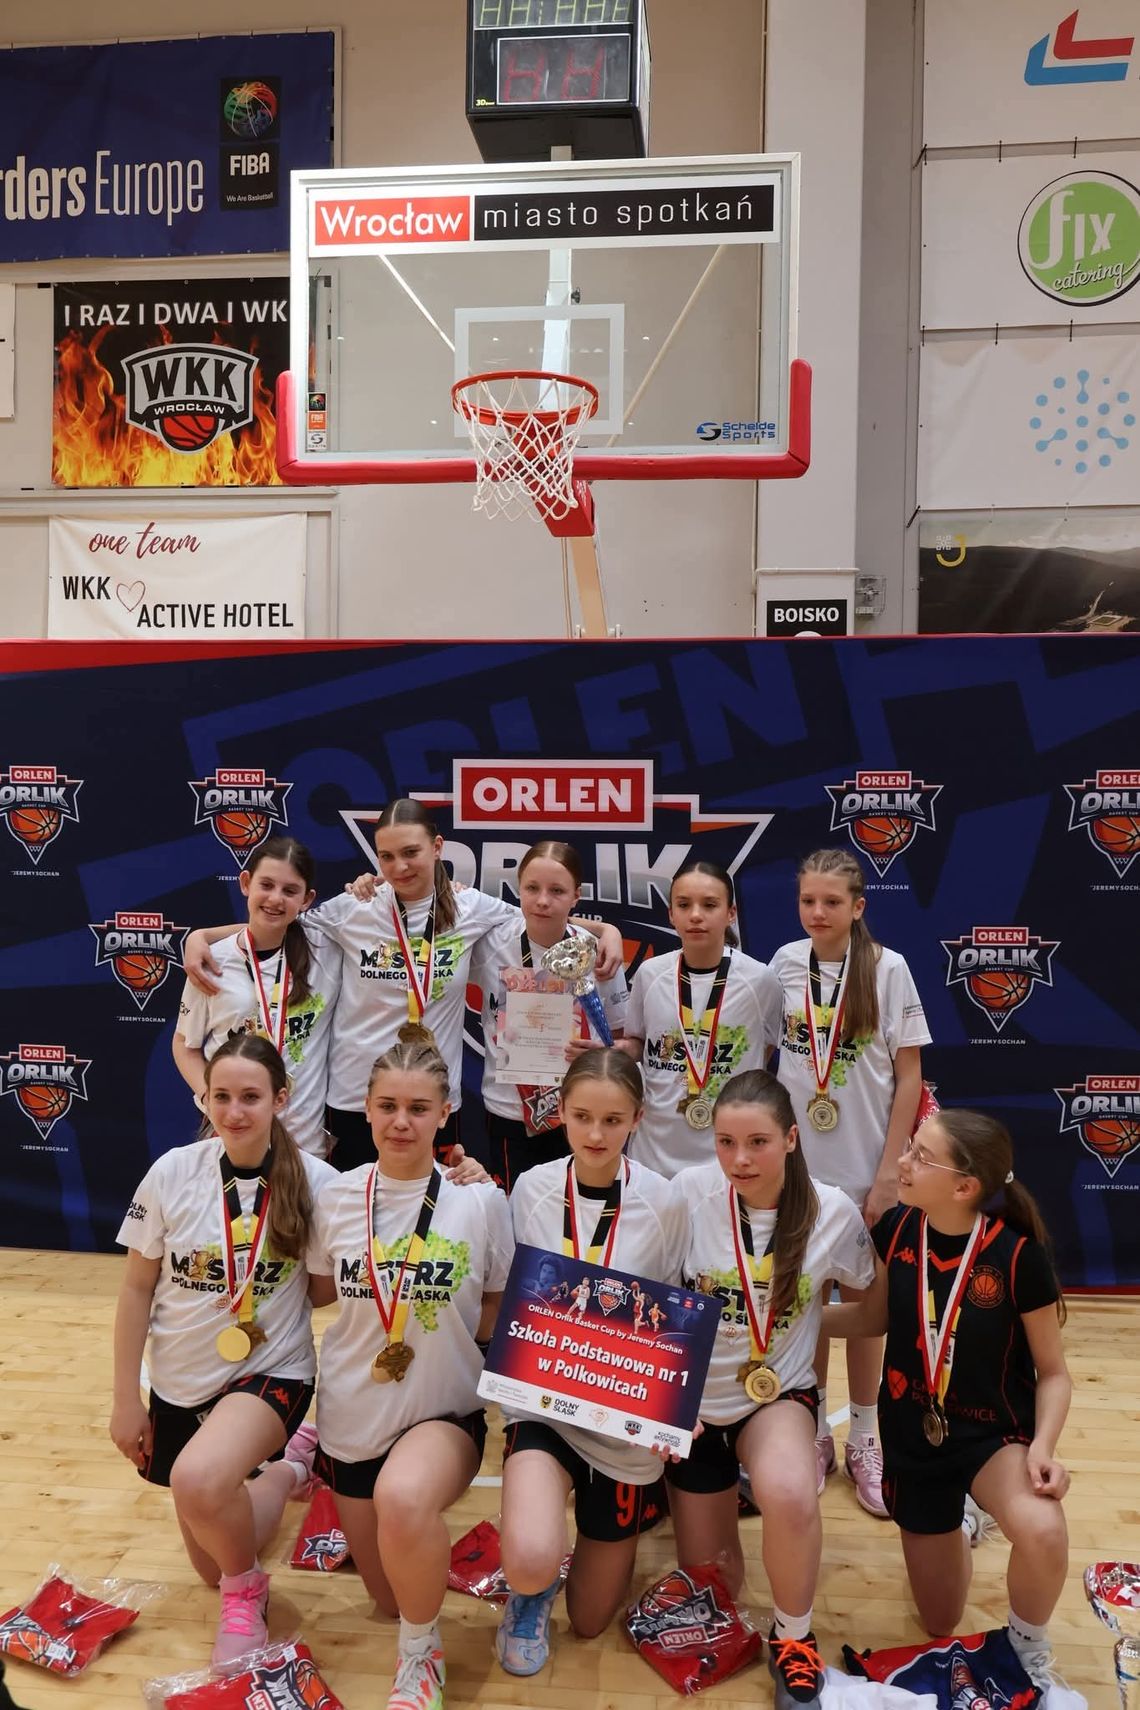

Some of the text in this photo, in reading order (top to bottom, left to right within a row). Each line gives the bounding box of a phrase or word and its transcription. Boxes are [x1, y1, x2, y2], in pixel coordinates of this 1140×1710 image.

[230, 152, 270, 176] FIBA
[95, 151, 204, 226] Europe
[320, 192, 752, 238] Wrocław miasto spotkań
[1052, 261, 1128, 291] catering
[64, 300, 288, 327] I RAZ I DWA I WK
[141, 356, 237, 402] WKK
[154, 402, 225, 416] WROCŁAW
[722, 422, 776, 431] Schelde
[722, 430, 776, 441] Sports
[88, 522, 201, 559] one team
[62, 576, 111, 600] WKK
[137, 603, 294, 628] ACTIVE HOTEL
[774, 607, 840, 623] BOISKO
[14, 770, 52, 780] ORLEN
[220, 773, 261, 783] ORLEN
[861, 776, 906, 786] ORLEN
[1101, 775, 1140, 785] ORLE
[0, 785, 69, 808] ORLIK
[204, 789, 278, 811] ORLIK
[472, 777, 633, 813] ORLEN
[841, 793, 925, 815] ORLIK
[1081, 792, 1140, 814] ORL
[440, 840, 692, 909] ORIK
[120, 916, 159, 926] ORLEN
[104, 932, 176, 954] ORLIK
[978, 931, 1023, 942] ORLEN
[958, 948, 1041, 970] ORLIK
[360, 970, 407, 980] DOLNEGO
[23, 1048, 61, 1059] ORLEN
[7, 1063, 78, 1086] ORLIK
[1091, 1080, 1137, 1089] ORLEN
[340, 1286, 375, 1299] DOLNE
[528, 1304, 555, 1317] ORLEN
[574, 1317, 600, 1331] Basket
[600, 1325, 616, 1336] Cup
[616, 1329, 627, 1340] by
[627, 1333, 656, 1348] Jeremy
[655, 1341, 683, 1355] Sochan
[508, 1320, 689, 1387] Szkoła Podstawowa nr 1
[538, 1357, 552, 1372] w
[554, 1359, 648, 1401] Polkowicach
[554, 1398, 580, 1410] DOLNY
[616, 1480, 636, 1527] 9
